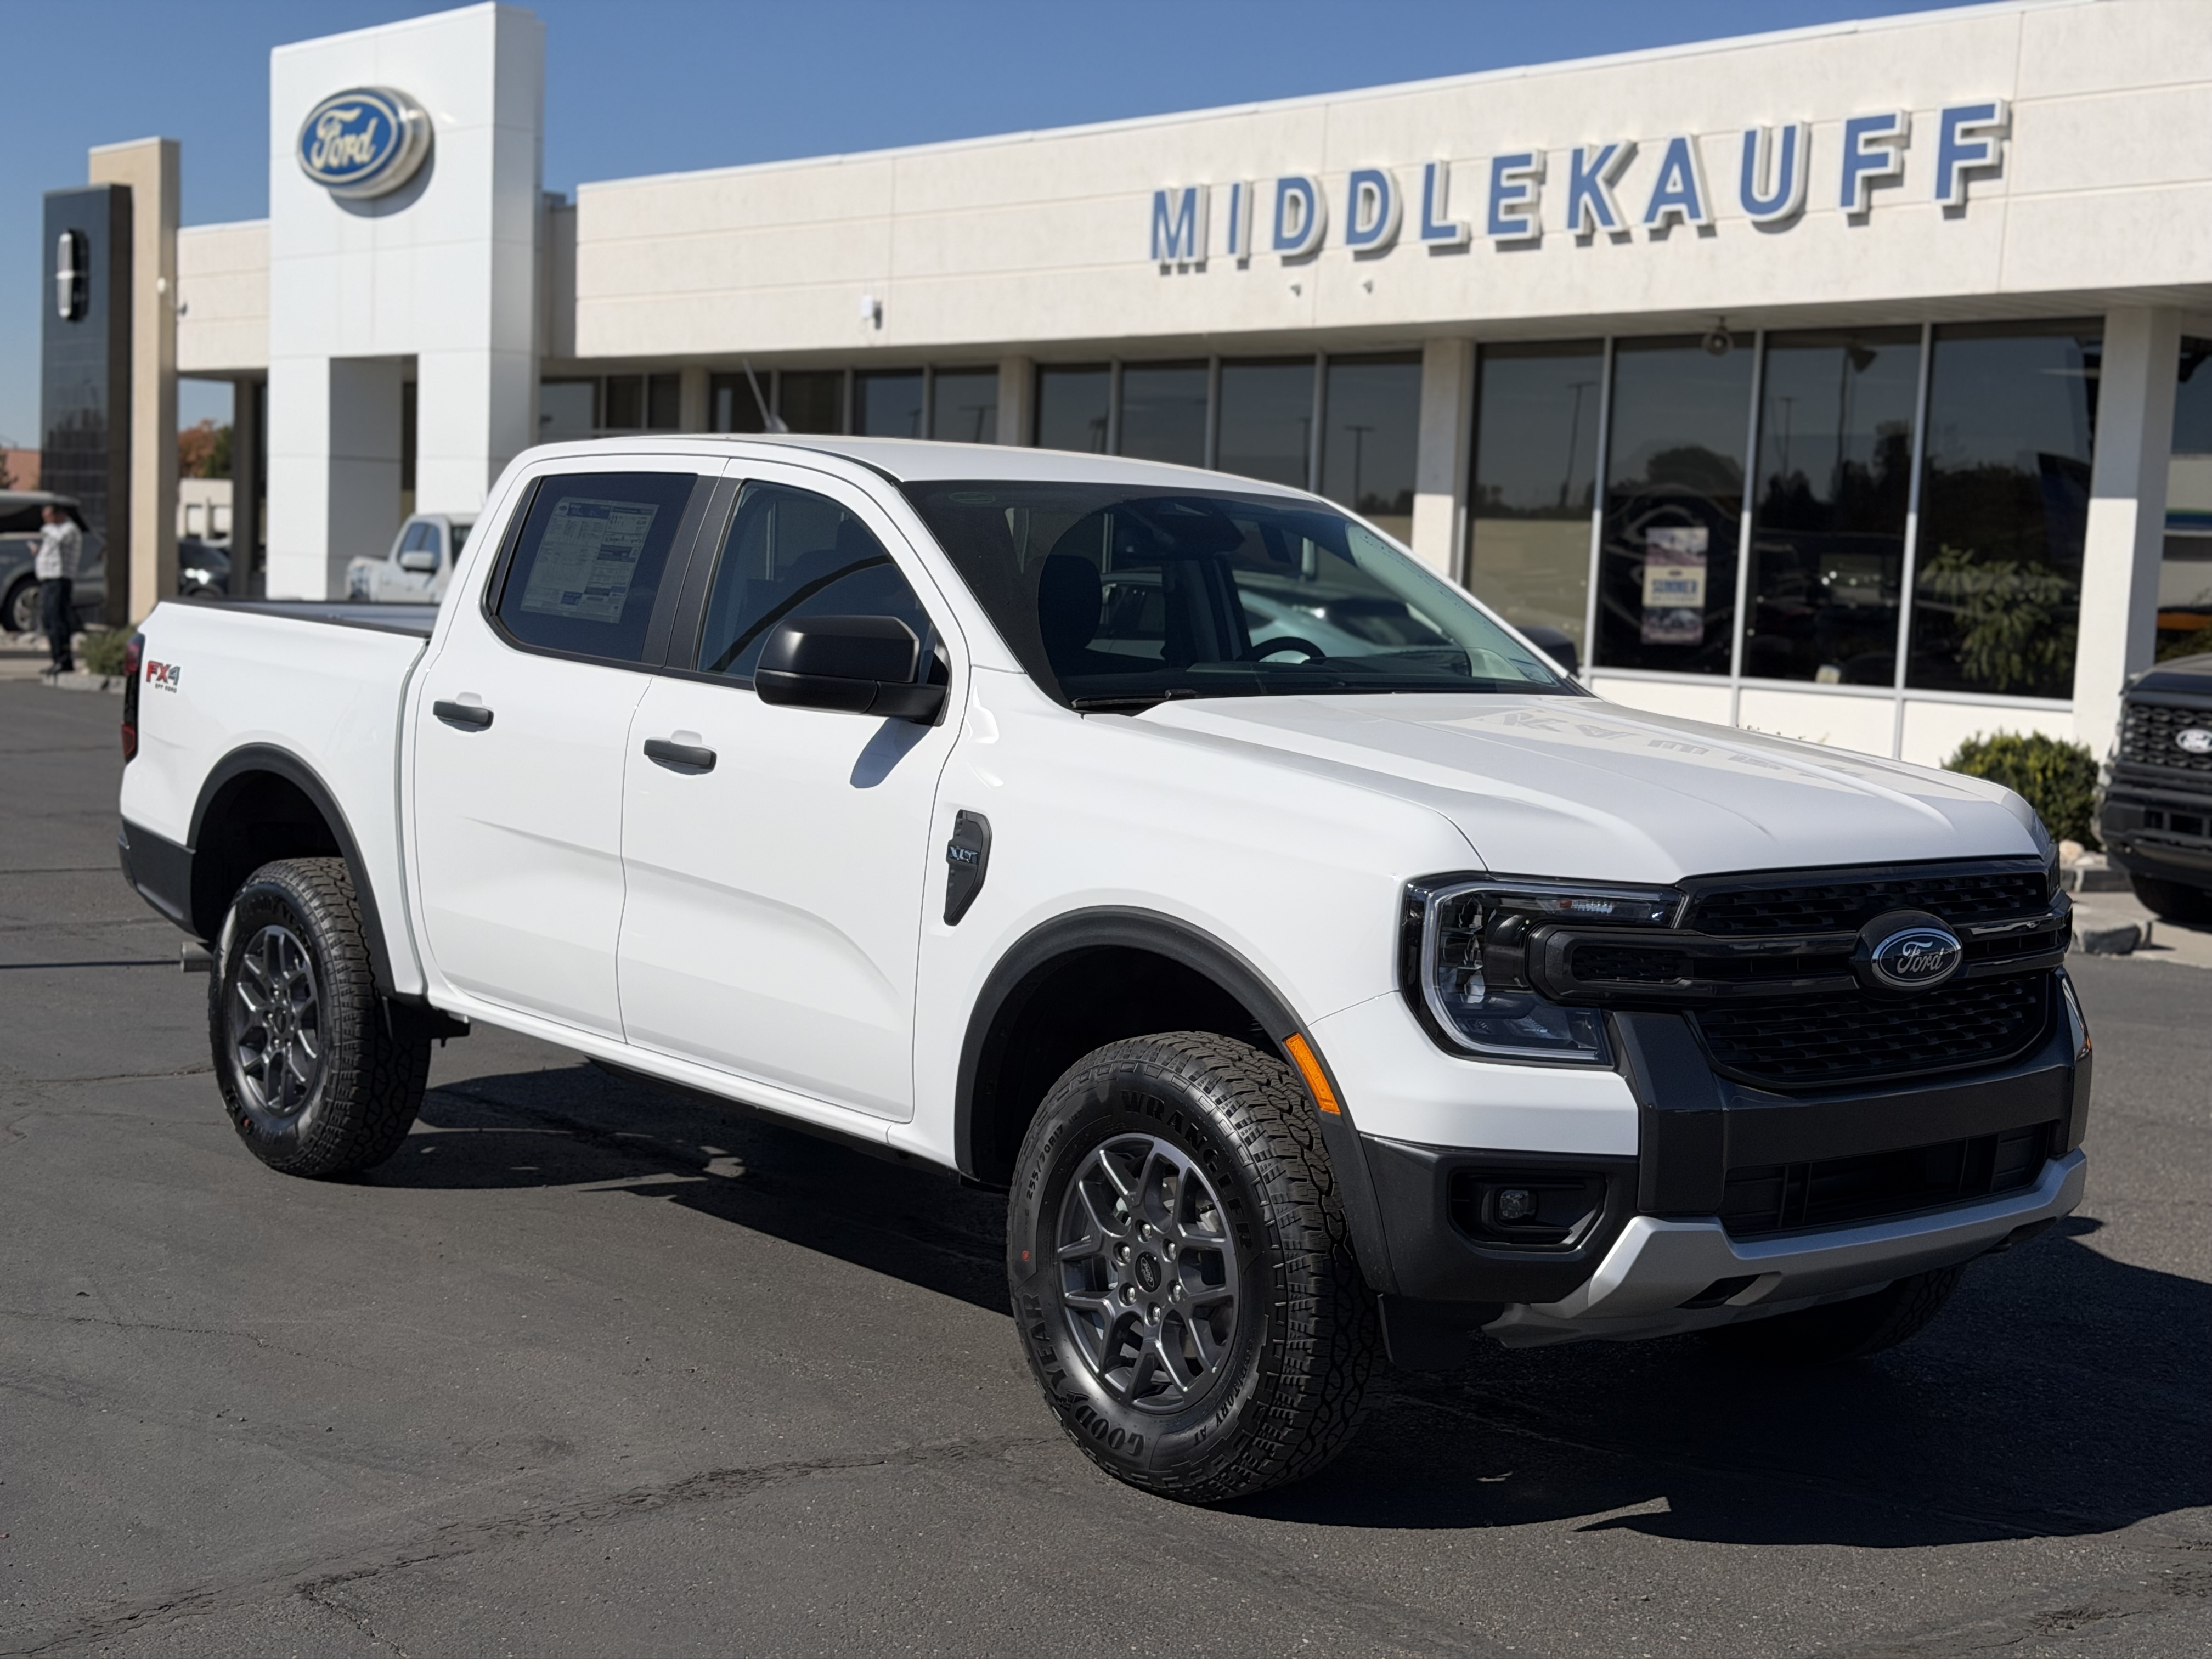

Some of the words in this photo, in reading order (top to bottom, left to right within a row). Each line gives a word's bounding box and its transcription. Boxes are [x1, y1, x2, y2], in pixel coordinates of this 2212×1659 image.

[311, 107, 379, 170] Ford
[1150, 99, 2010, 268] MIDDLEKAUFF
[146, 660, 180, 686] FX4
[949, 845, 979, 863] XLT
[1897, 941, 1944, 974] Ford
[1026, 1123, 1064, 1201] 255/70R17
[1121, 1090, 1253, 1248] WRANGLER
